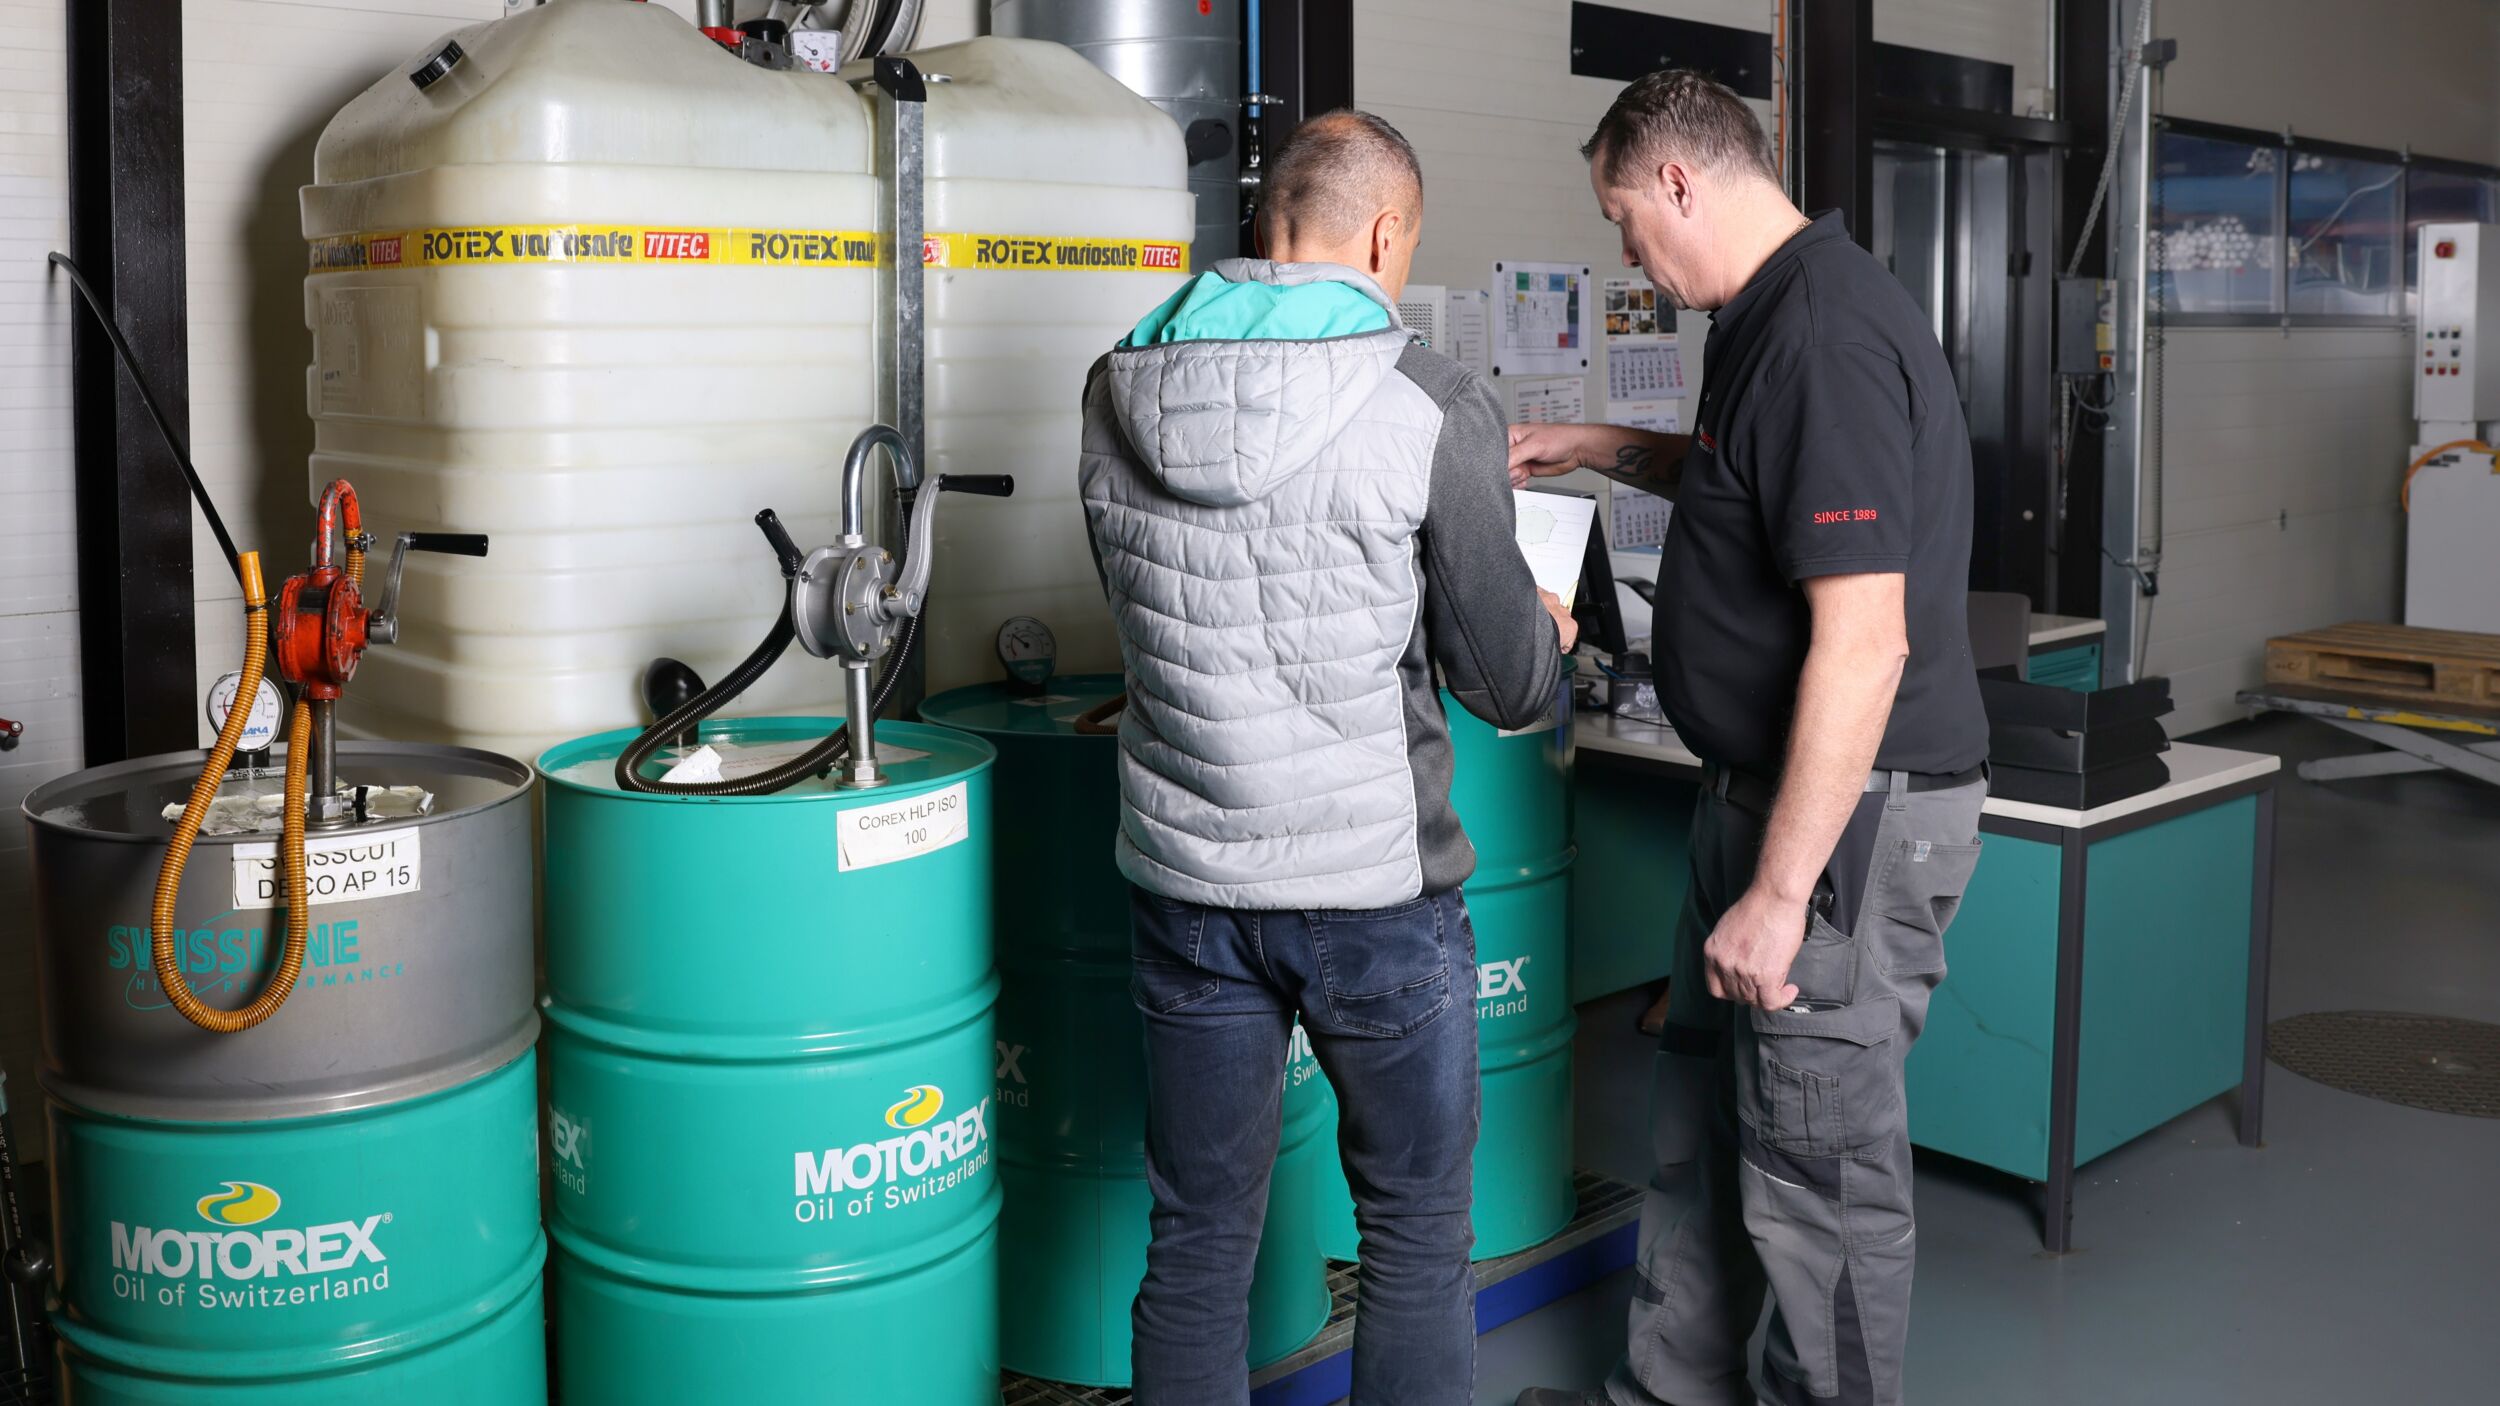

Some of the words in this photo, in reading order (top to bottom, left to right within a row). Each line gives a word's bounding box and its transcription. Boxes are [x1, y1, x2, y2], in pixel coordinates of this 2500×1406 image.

[372, 241, 399, 262] TITEC
[423, 230, 503, 260] ROTEX
[645, 233, 705, 257] TITEC
[751, 232, 838, 260] ROTEX
[977, 239, 1052, 264] ROTEX
[1057, 242, 1136, 266] variosafe
[1143, 245, 1178, 267] TITEC
[1814, 510, 1850, 524] SINCE
[1853, 509, 1877, 521] 1989
[859, 812, 907, 831] COREX
[910, 801, 936, 821] HLP
[938, 794, 957, 812] ISO
[904, 827, 927, 845] 100
[343, 870, 377, 894] AP
[386, 865, 410, 888] 15
[136, 977, 197, 994] HIH
[795, 1197, 833, 1223] Oil
[848, 1191, 874, 1217] of
[885, 1143, 988, 1209] Switzerland
[113, 1273, 145, 1302] Oil
[158, 1283, 186, 1307] of
[199, 1265, 389, 1308] Switzerland
